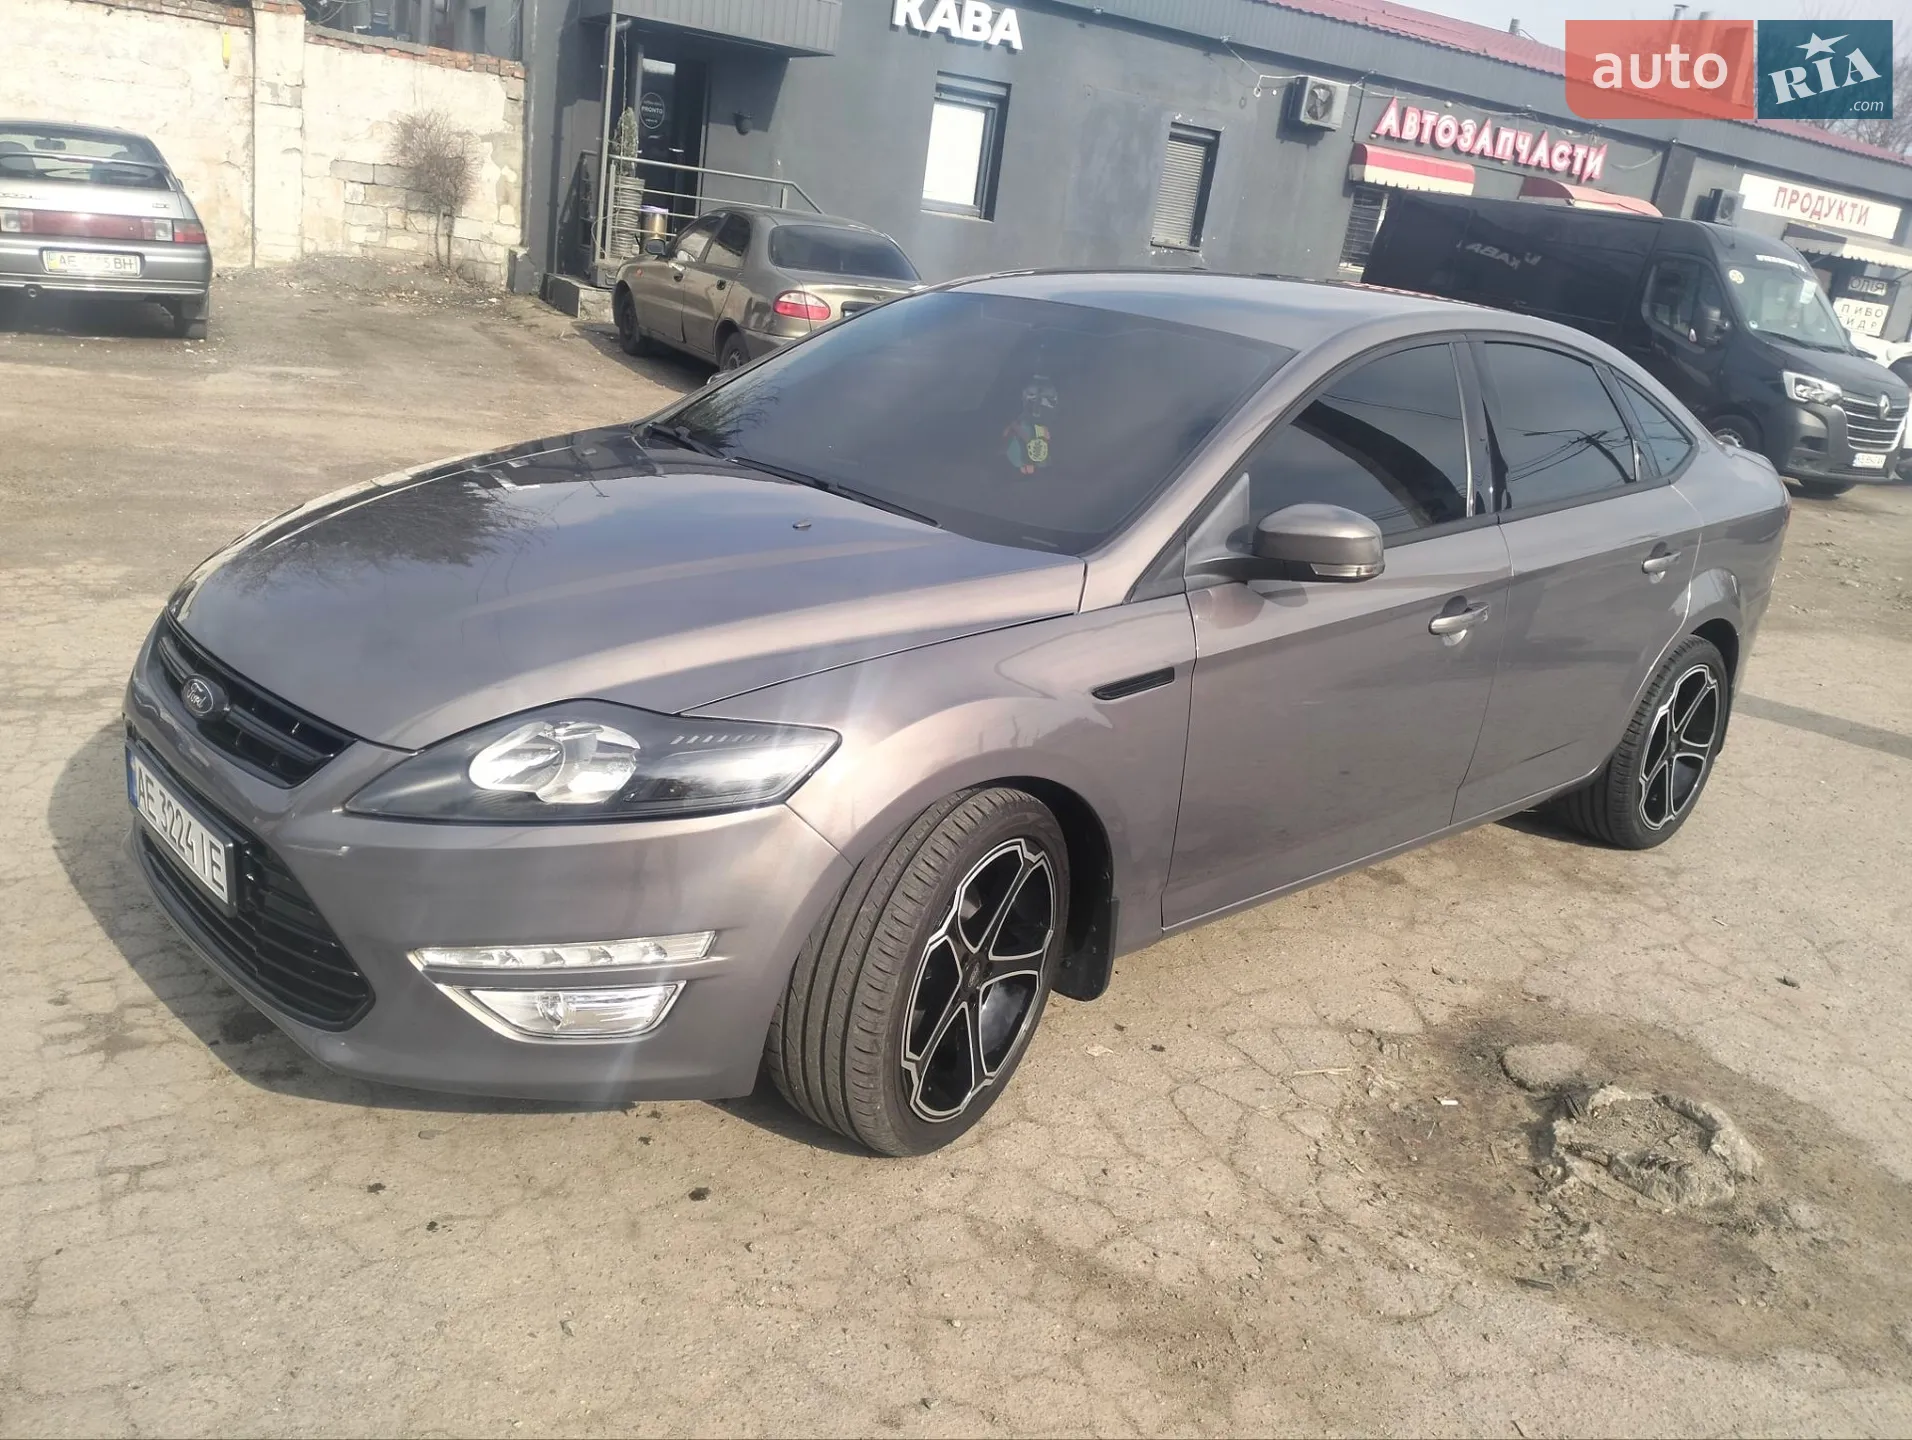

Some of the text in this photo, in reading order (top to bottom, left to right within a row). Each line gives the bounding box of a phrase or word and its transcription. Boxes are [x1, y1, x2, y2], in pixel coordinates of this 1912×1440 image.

[892, 0, 1023, 50] КАВА
[1375, 96, 1608, 184] АВТОЗАПЧАСТИ
[1774, 186, 1871, 227] ПРОДУКТИ
[186, 682, 207, 708] Ford
[138, 766, 226, 893] AE 3224 IE
